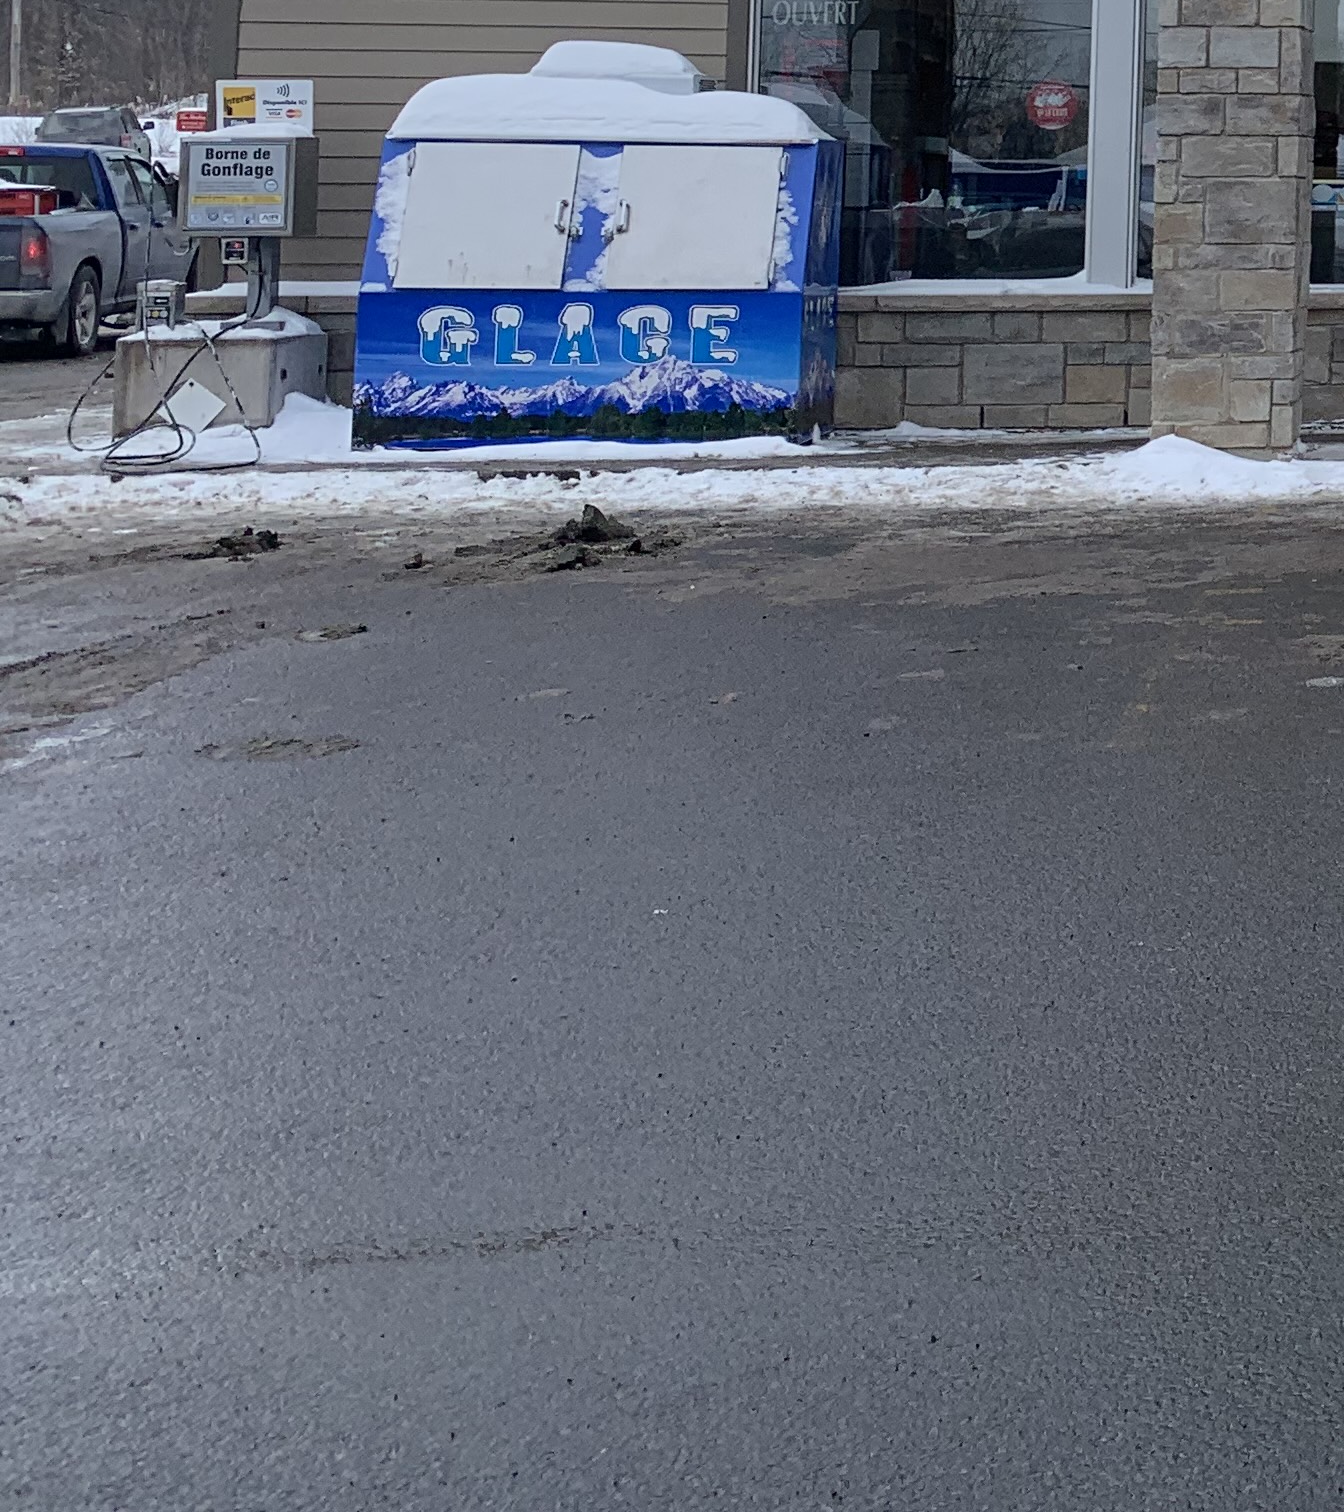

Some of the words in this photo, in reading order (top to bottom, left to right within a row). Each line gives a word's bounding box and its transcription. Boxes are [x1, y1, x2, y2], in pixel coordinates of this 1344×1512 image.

[772, 0, 860, 25] OUVERT
[205, 148, 248, 160] Borne
[253, 148, 271, 160] de
[201, 163, 274, 179] Gonflage
[416, 303, 739, 366] GLACE
